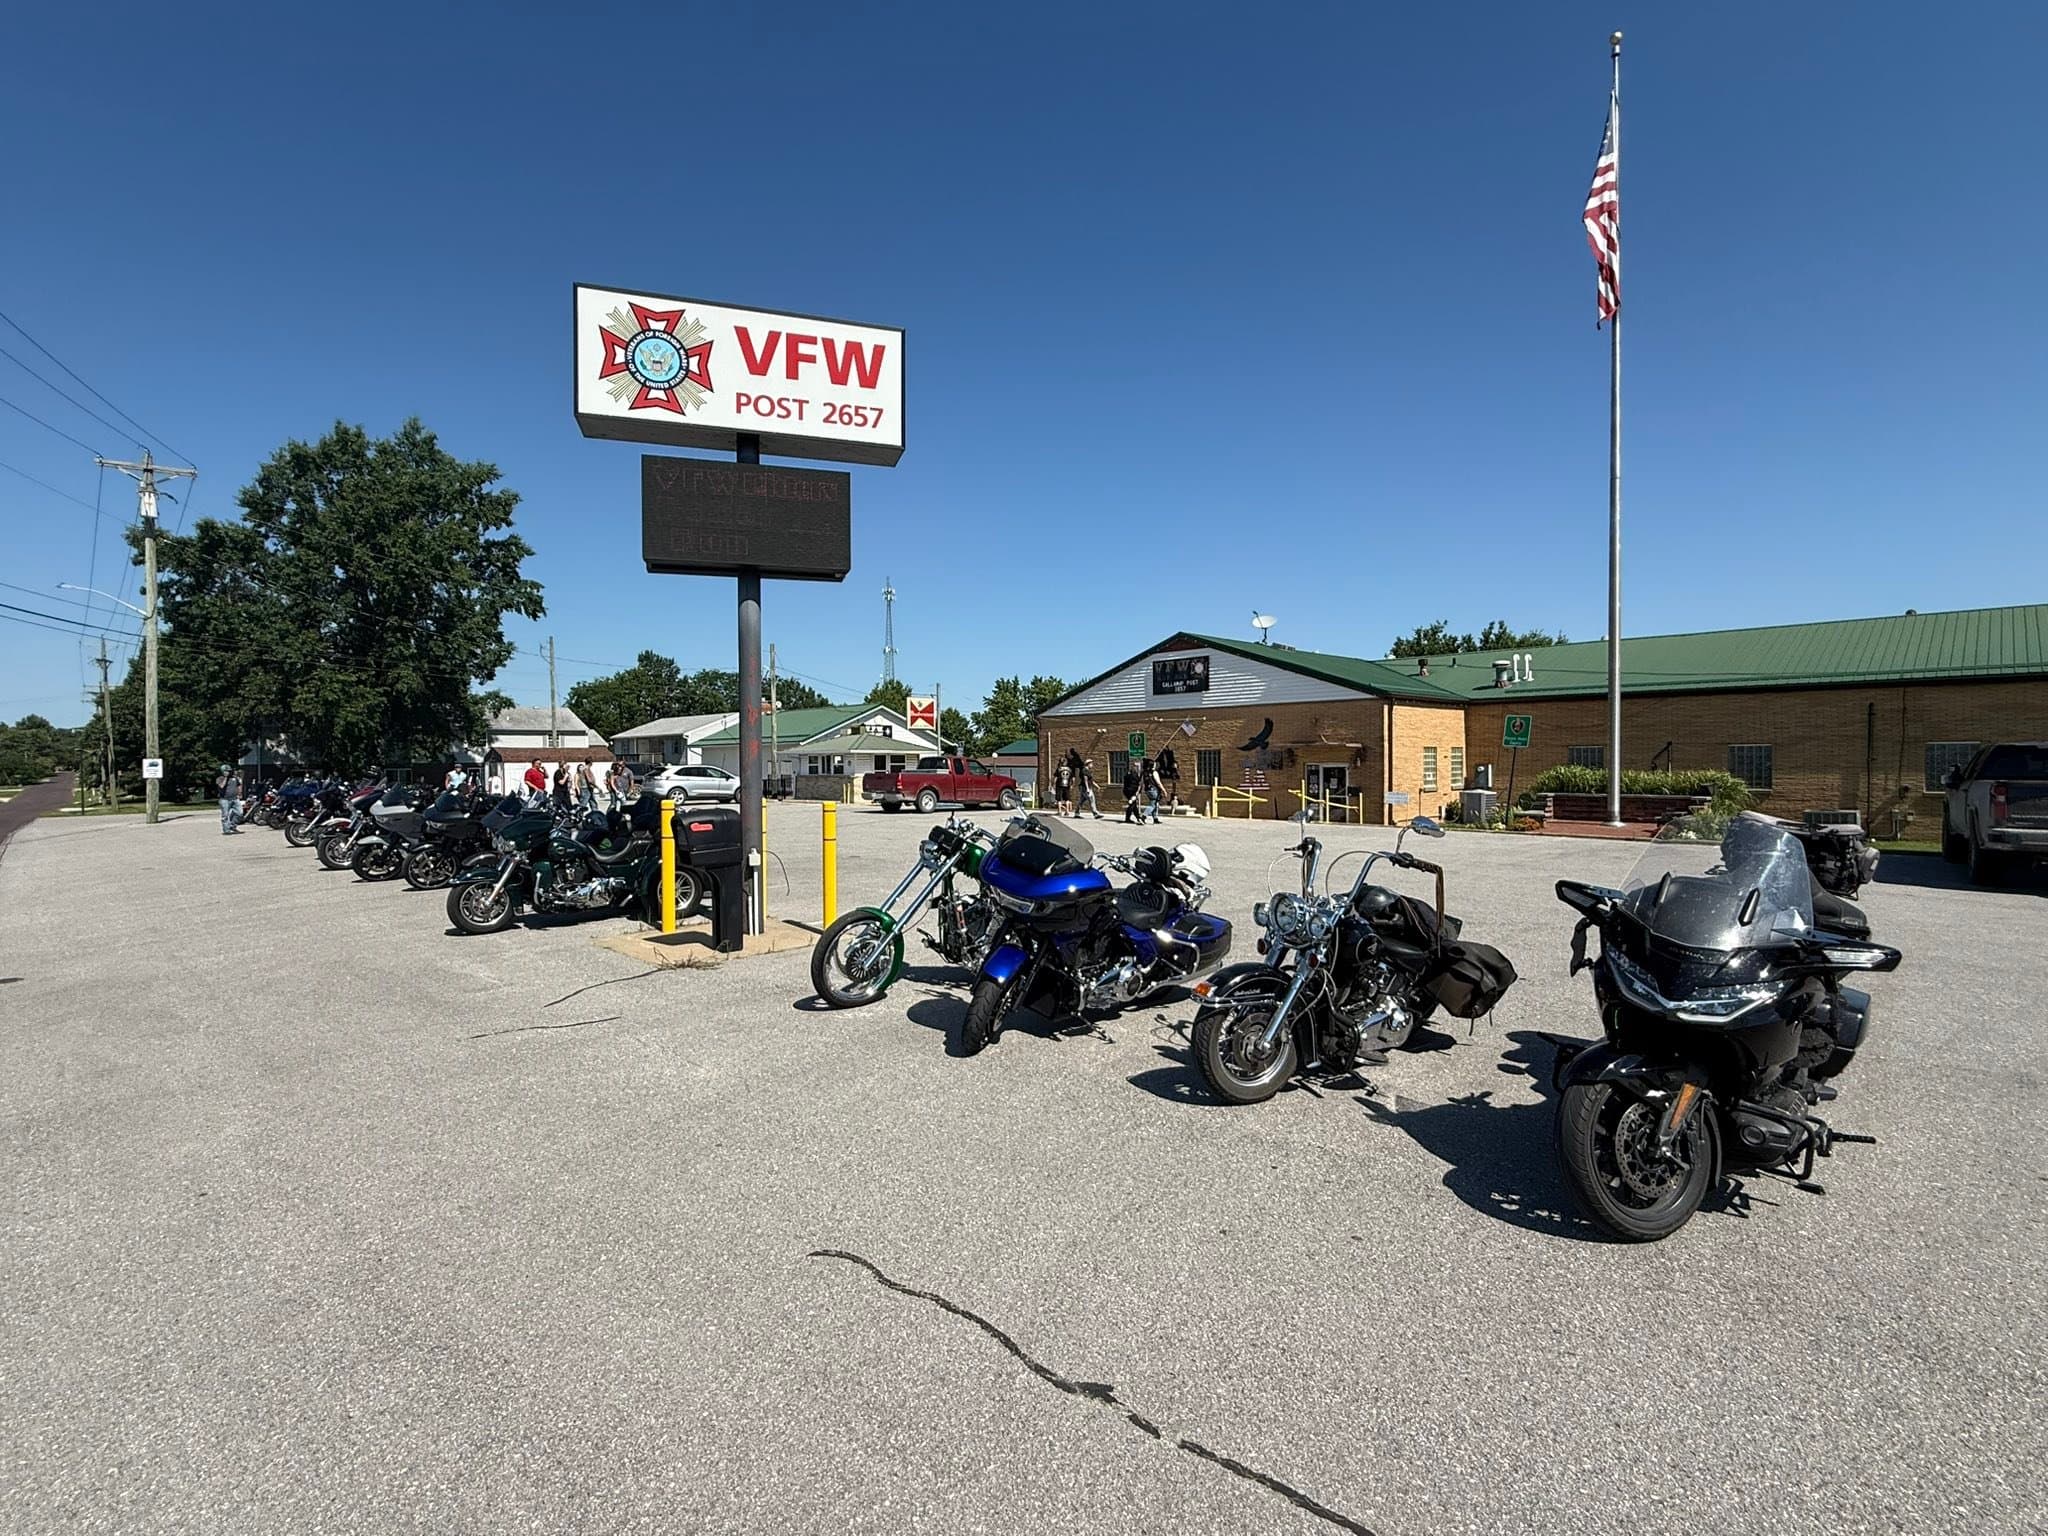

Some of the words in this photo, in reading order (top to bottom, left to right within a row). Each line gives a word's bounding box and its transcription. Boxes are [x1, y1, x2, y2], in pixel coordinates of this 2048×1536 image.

[733, 325, 886, 389] VFW
[736, 392, 809, 421] POST
[822, 402, 884, 429] 2657
